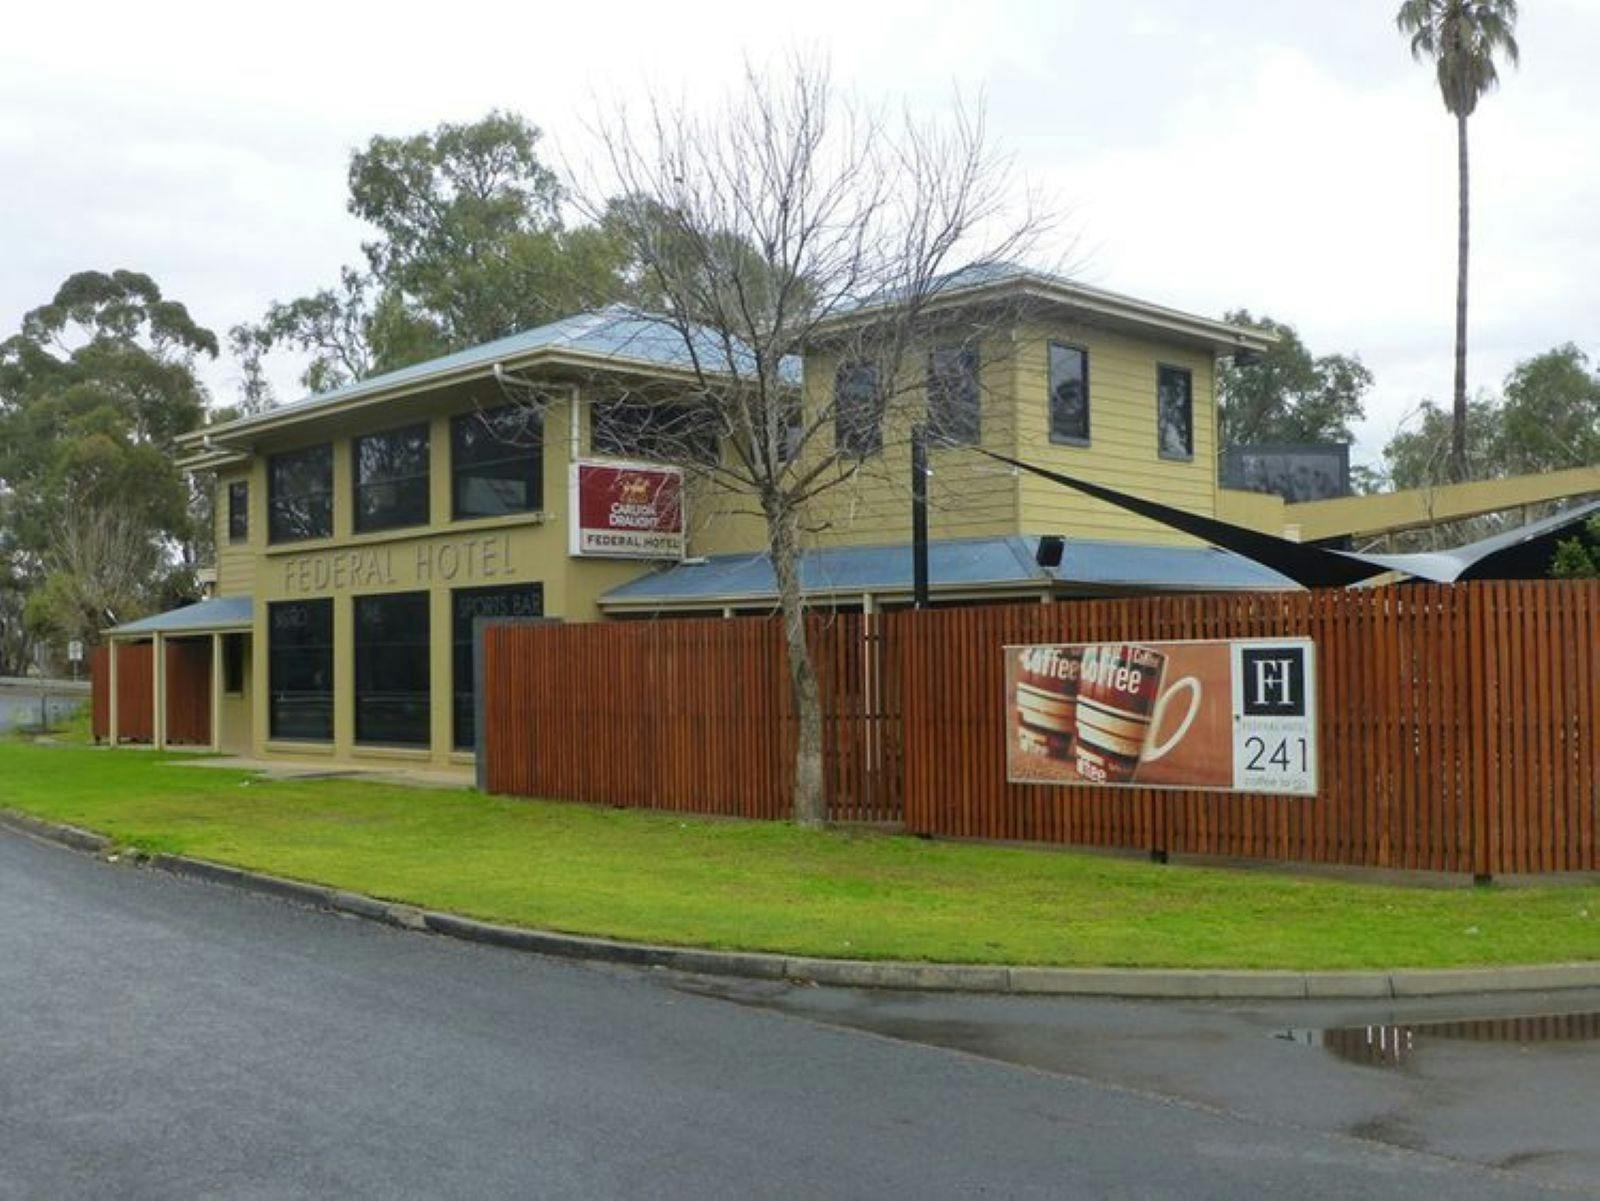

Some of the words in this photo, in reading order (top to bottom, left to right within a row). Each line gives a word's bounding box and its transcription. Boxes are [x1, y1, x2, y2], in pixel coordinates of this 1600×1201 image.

[587, 534, 640, 548] FEDERAL
[643, 537, 680, 549] HOTEL
[284, 549, 397, 593] FEDERAL
[416, 533, 517, 581] HOTEL
[1244, 736, 1308, 773] 241
